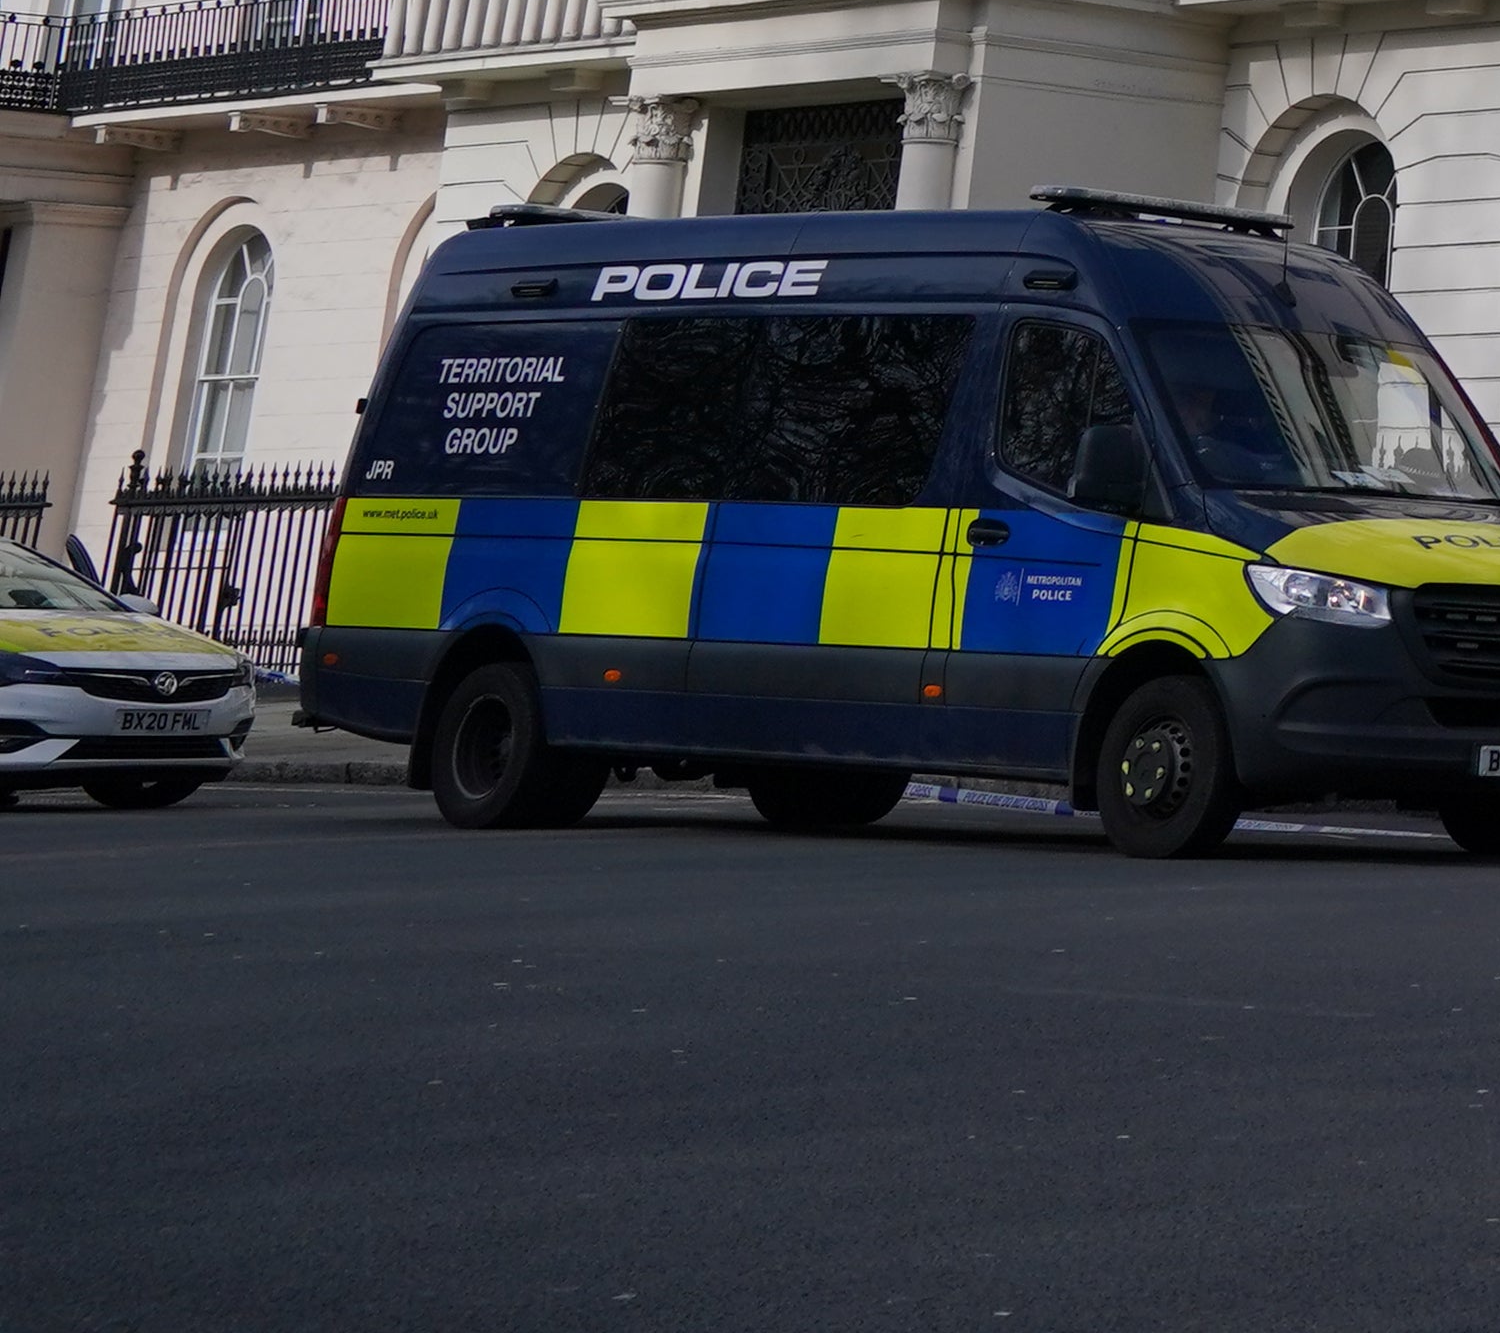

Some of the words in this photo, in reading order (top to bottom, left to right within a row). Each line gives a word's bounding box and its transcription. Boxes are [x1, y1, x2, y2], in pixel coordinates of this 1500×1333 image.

[590, 260, 829, 302] POLICE
[439, 356, 566, 384] TERRITORIAL
[443, 392, 541, 418] SUPPORT
[444, 427, 519, 455] GROUP
[365, 460, 395, 480] JPR
[1026, 575, 1083, 587] METROPOLITAN
[1031, 588, 1073, 601] POLICE
[121, 712, 167, 730] BX20
[170, 712, 201, 730] FML
